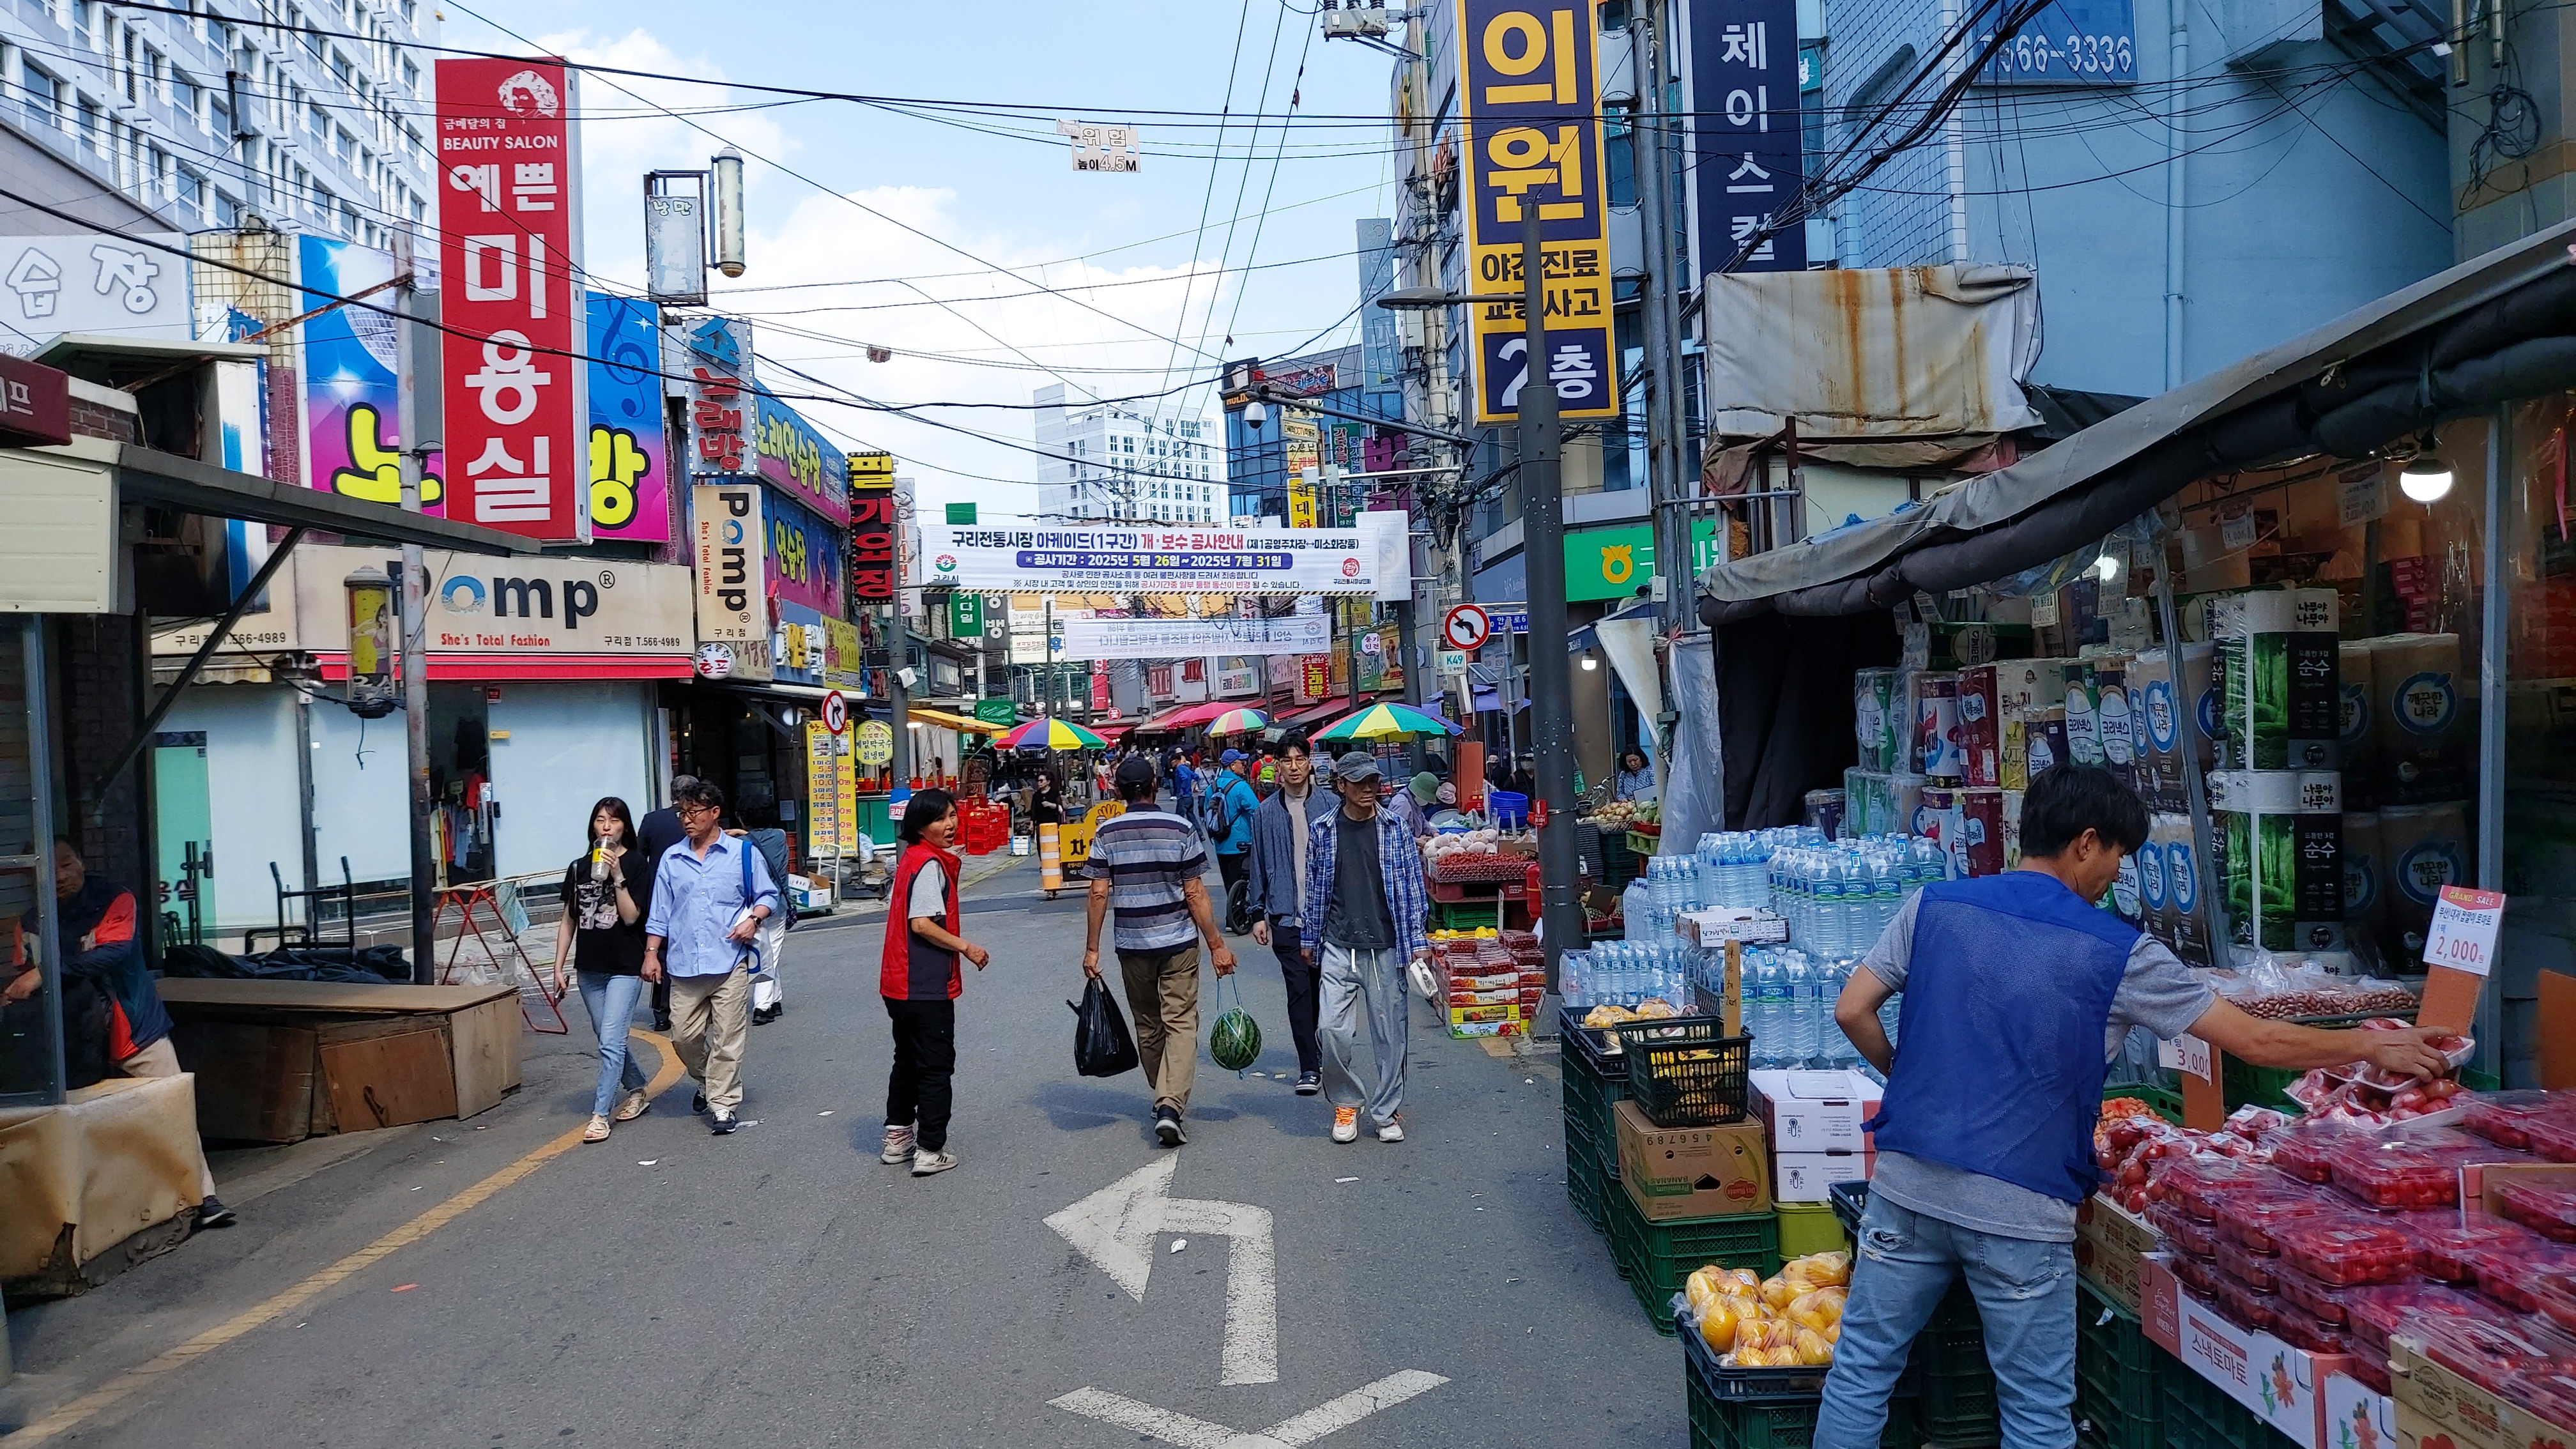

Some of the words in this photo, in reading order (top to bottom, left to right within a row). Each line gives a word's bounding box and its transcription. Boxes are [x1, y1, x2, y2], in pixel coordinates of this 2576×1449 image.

[1979, 34, 2133, 74] T566-3336
[443, 118, 491, 130] 금메달의
[494, 117, 507, 130] 집
[1482, 9, 1584, 223] 의원
[443, 137, 500, 151] BEAUTY
[505, 135, 558, 150] SALON
[1082, 128, 1126, 147] 위험
[449, 162, 558, 212] 예쁜
[652, 199, 693, 218] 낭만
[463, 234, 553, 523] 미용실
[1497, 338, 1597, 408] 2층
[692, 367, 745, 470] 노래방
[701, 521, 709, 541] She's
[850, 497, 894, 597] 가요장
[952, 530, 1033, 548] 구리전통시장
[1037, 532, 1137, 549] 아케이드(1구간)
[1192, 534, 1244, 550] 공사안내
[702, 544, 711, 565] Total
[717, 492, 750, 612] Pomp
[1034, 553, 1078, 566] 공사기간
[1088, 554, 1130, 567] 2025년
[1132, 554, 1151, 567] 5월
[1234, 555, 1253, 567] 7월
[1256, 555, 1282, 567] 31일
[703, 566, 713, 595] Fashion
[1061, 571, 1084, 579] 공사로
[1086, 571, 1101, 579] 인한
[1102, 571, 1131, 579] 공사소음
[1133, 571, 1142, 579] 등
[1143, 571, 1158, 579] 여러
[1024, 579, 1039, 588] 시장
[1041, 579, 1048, 588] 내
[1076, 580, 1099, 588] 상인의
[1124, 580, 1139, 588] 위해
[1140, 581, 1178, 589] 공사기간중
[2297, 601, 2327, 612] 나무야
[2296, 614, 2329, 627] 나무야
[441, 632, 470, 647] She's
[476, 633, 505, 647] Total
[510, 633, 550, 647] Fashion
[714, 628, 746, 638] 구리점
[604, 636, 632, 648] 구리점
[637, 636, 680, 648] T.566-4989
[1446, 655, 1463, 665] K49
[2297, 659, 2331, 677] 순수
[1151, 670, 1170, 693] BYC
[1307, 664, 1323, 696] 노래방
[2407, 692, 2442, 706] 깨끗한
[2413, 705, 2441, 719] 나라
[2067, 719, 2094, 734] 크리넥스
[2102, 719, 2131, 735] 크리넥스
[2303, 783, 2333, 795] 나무야
[2302, 795, 2335, 809] 나무야
[1070, 838, 1086, 856] 차
[2303, 841, 2337, 859] 순수
[2412, 861, 2448, 875] 깨끗한
[2418, 873, 2444, 887] 나라
[2449, 892, 2473, 902] GRAND
[2476, 896, 2495, 906] SALE
[2439, 907, 2451, 919] 부산
[2475, 913, 2492, 926] 토마토
[2435, 936, 2485, 963] 2,000원
[2177, 1048, 2209, 1076] 3,000
[1647, 1136, 1654, 1146] 9
[1657, 1135, 1664, 1145] 8
[1669, 1135, 1676, 1144] 7
[1680, 1134, 1687, 1144] 6
[1693, 1133, 1699, 1143] 5
[1650, 1176, 1689, 1184] BANANAS
[1655, 1184, 1690, 1193] Premium
[2191, 1333, 2249, 1386] 스낵토마토
